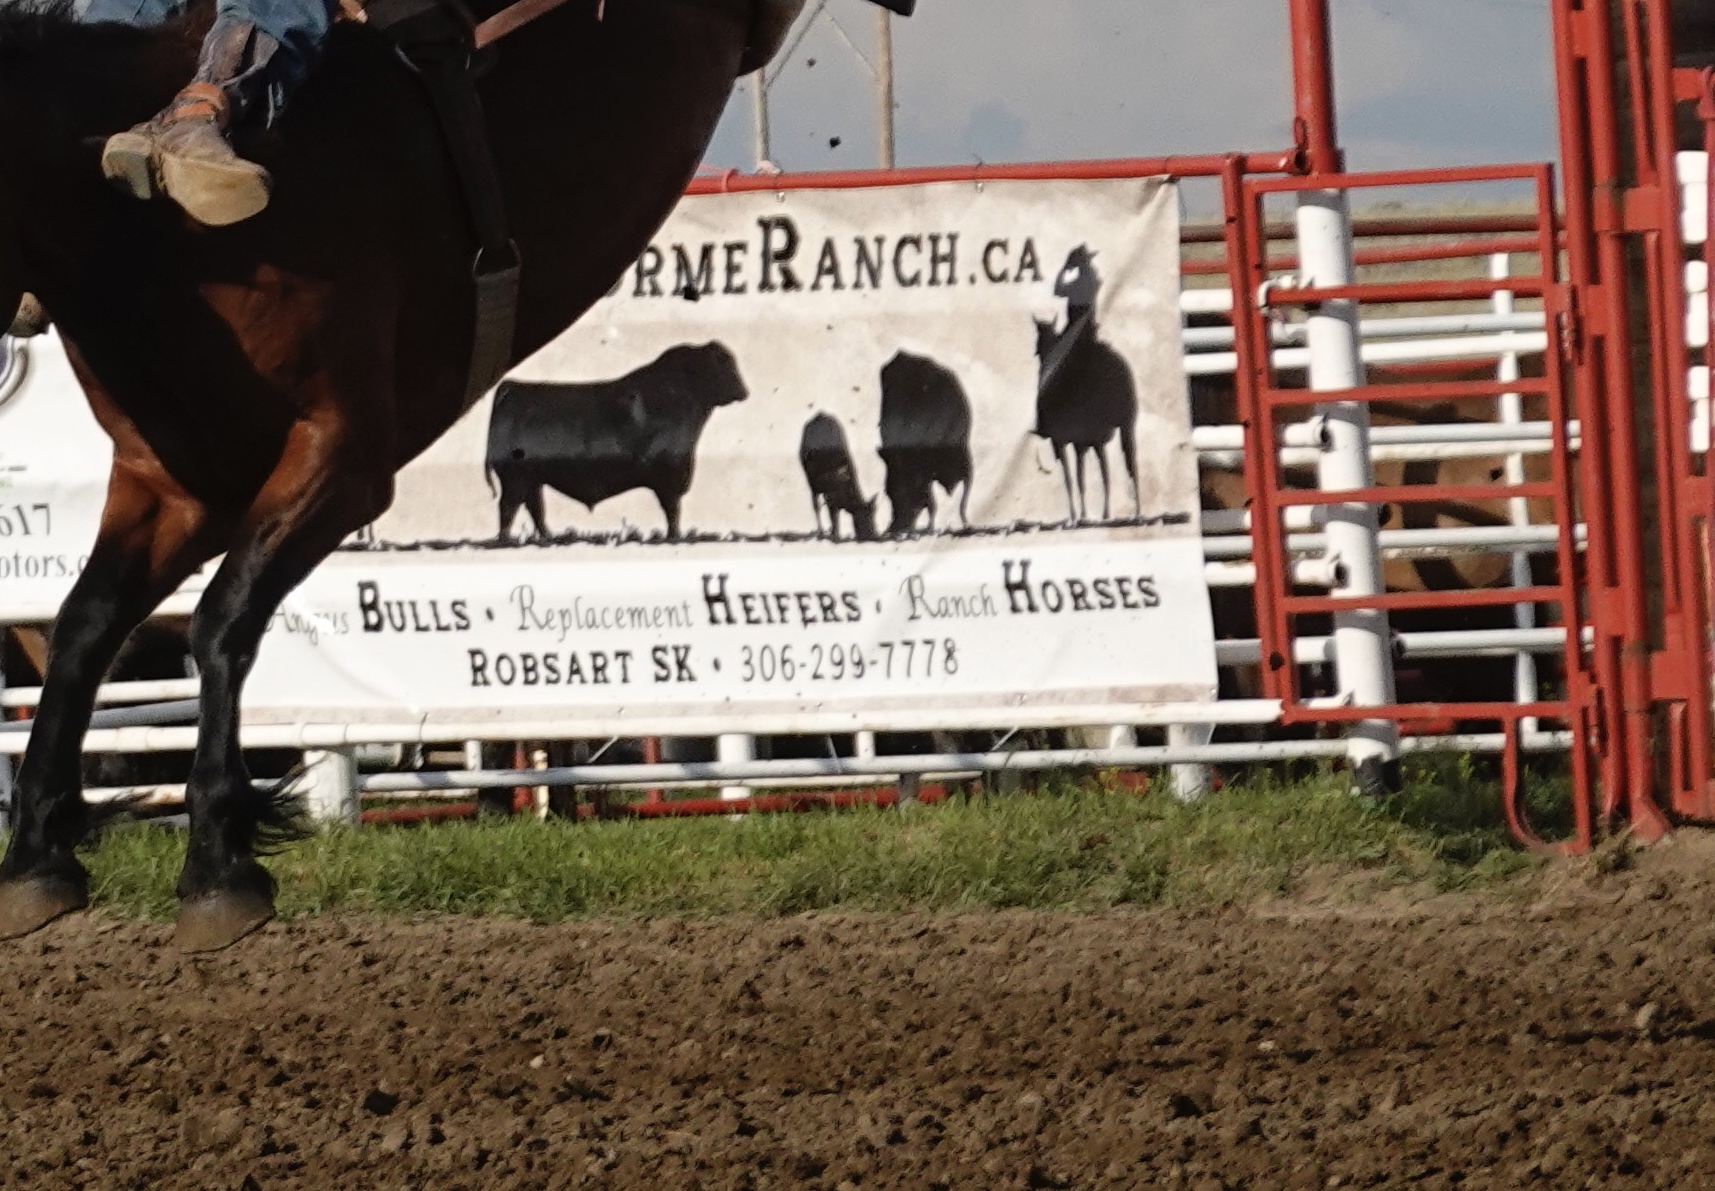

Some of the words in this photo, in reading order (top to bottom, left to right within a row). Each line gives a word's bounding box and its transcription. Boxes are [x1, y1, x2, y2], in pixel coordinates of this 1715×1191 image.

[509, 584, 693, 643] Replacement
[898, 573, 999, 621] Ranch
[468, 648, 634, 686] ROBSART
[651, 644, 697, 683] SK
[740, 637, 959, 683] 306-299-7778
